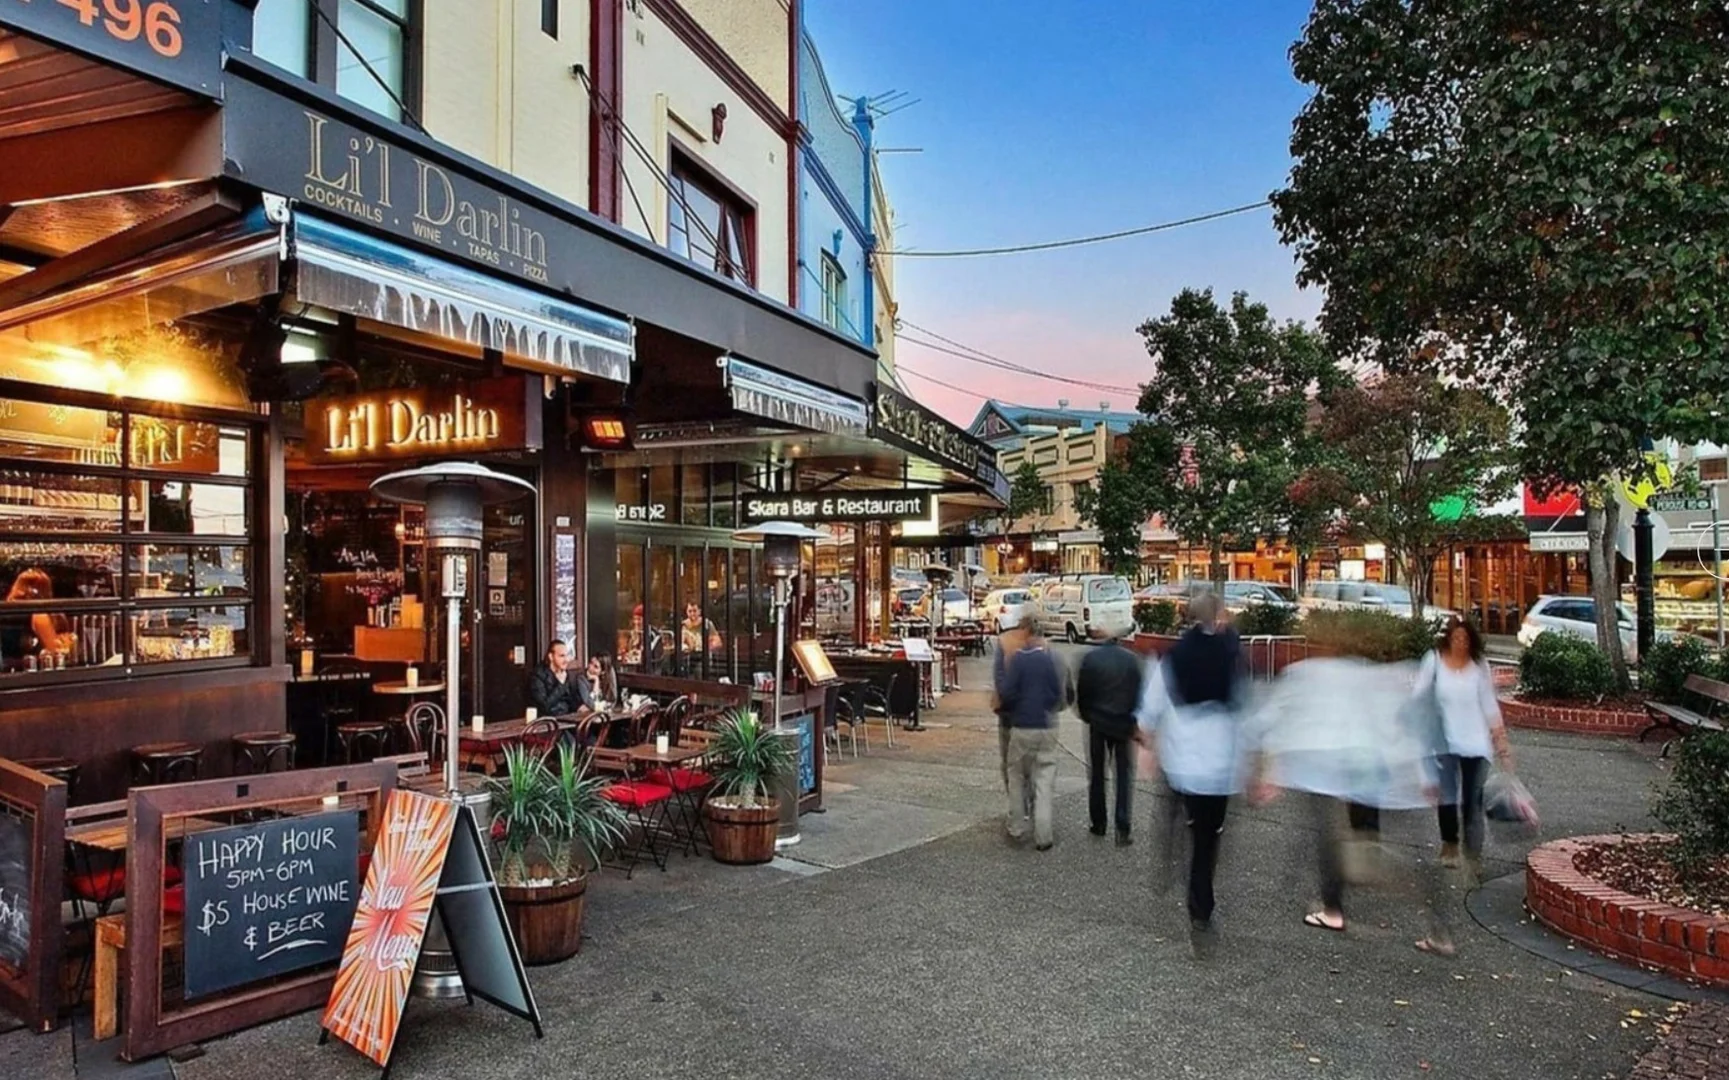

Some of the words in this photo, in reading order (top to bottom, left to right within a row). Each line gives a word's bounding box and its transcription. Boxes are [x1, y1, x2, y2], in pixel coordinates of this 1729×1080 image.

[304, 111, 392, 208] Li'l
[414, 157, 547, 267] Darlin
[304, 183, 383, 224] COCKTAILS
[412, 221, 442, 244] WINE
[468, 242, 500, 265] TAPAS
[523, 263, 549, 282] PIZZA
[324, 404, 378, 453] Li'l
[386, 395, 499, 447] Darlin
[748, 500, 789, 517] Skara
[793, 499, 819, 515] Bar
[822, 499, 834, 515] &
[837, 497, 921, 515] Restaurant
[199, 832, 266, 879] HAPPY
[282, 827, 337, 855] HOUR
[197, 899, 231, 937] $5
[243, 886, 303, 915] HOUSE
[305, 880, 350, 905] WINE
[268, 912, 325, 944] BEER
